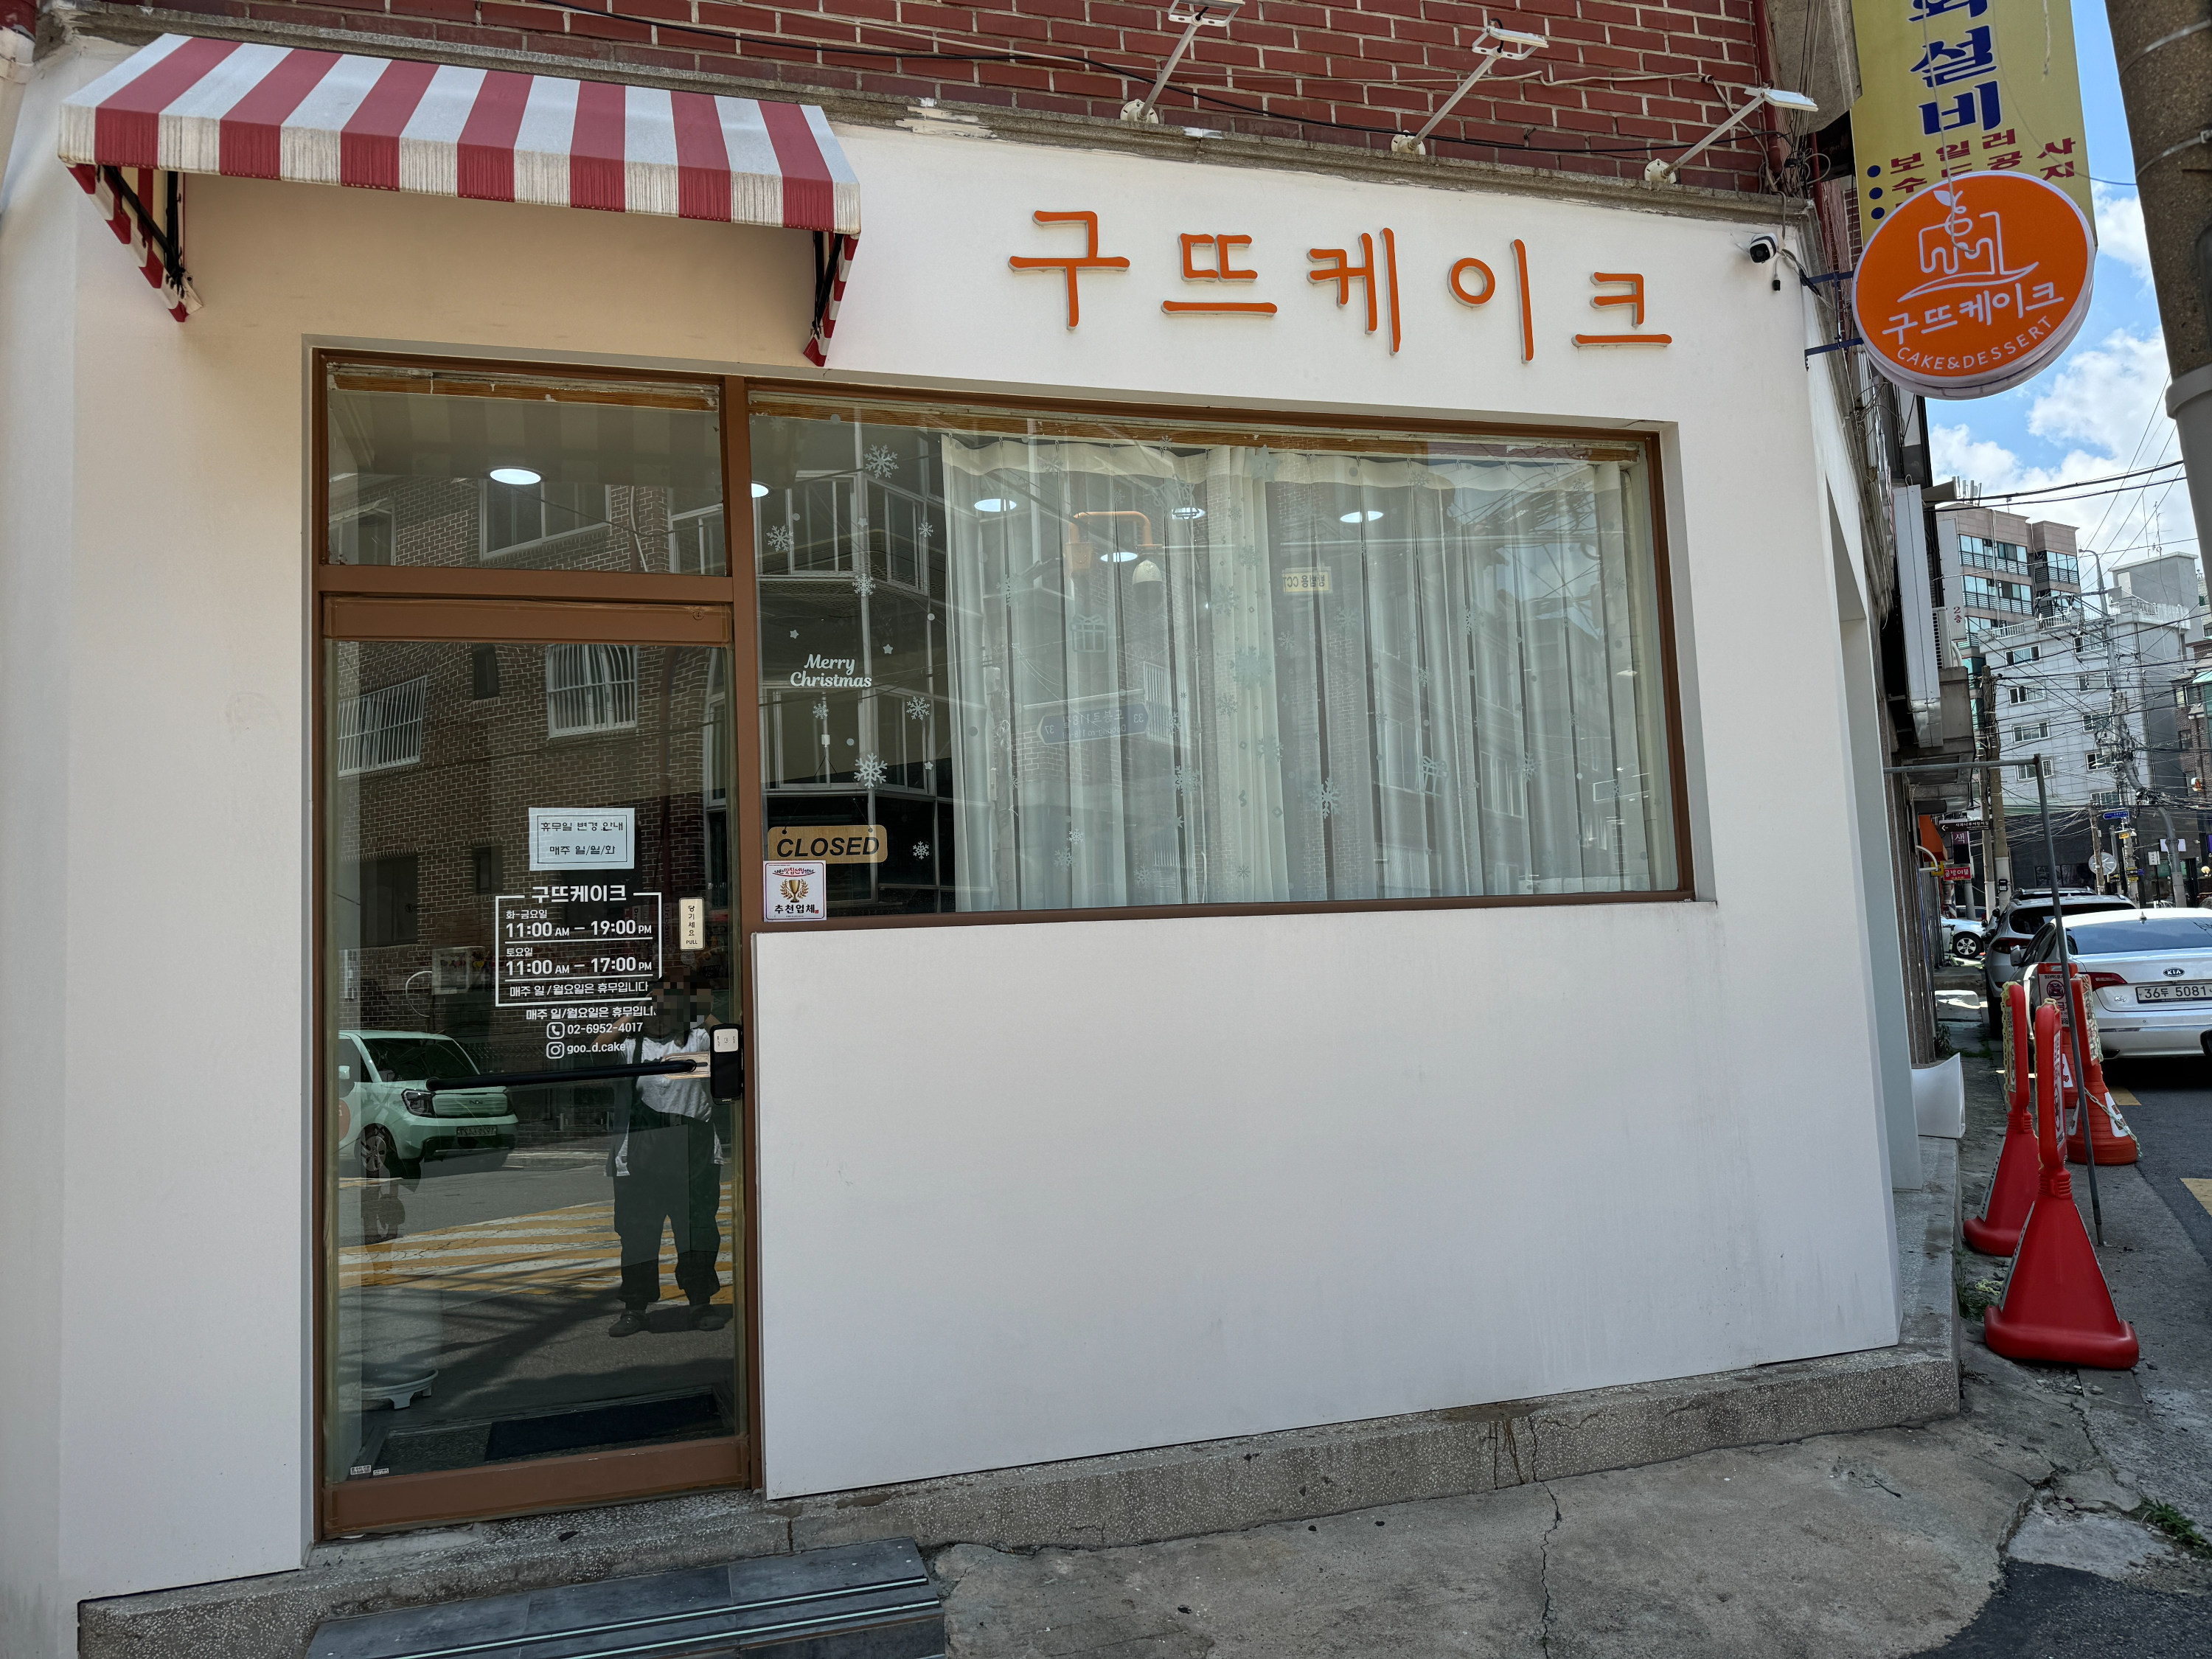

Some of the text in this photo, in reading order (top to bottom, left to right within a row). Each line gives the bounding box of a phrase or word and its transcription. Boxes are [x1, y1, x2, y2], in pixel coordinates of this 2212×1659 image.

[1891, 128, 2017, 175] 보일러
[1008, 209, 1673, 364] 구뜨케이크
[1882, 282, 2065, 345] 구뜨케이크
[1897, 316, 2052, 369] CAKE&DESSERT
[1953, 606, 1963, 623] 2층
[804, 654, 855, 675] Merry
[790, 670, 872, 688] Christmas
[540, 822, 623, 832] 휴무일 변경 안내
[549, 845, 616, 855] 매주 일/월/화
[776, 836, 880, 858] CLOSED
[532, 885, 627, 903] 구뜨케이크
[506, 909, 548, 919] 화-금요일
[774, 904, 815, 914] 추천업체
[506, 922, 552, 938] 11:00
[554, 927, 570, 936] AM
[591, 920, 636, 936] 19:00
[638, 925, 652, 933] PM
[506, 947, 533, 957] 토요일
[506, 959, 552, 975] 11:00
[554, 964, 570, 974] AM
[591, 957, 636, 973] 17:00
[638, 961, 653, 971] PM
[509, 986, 531, 997] 매주
[597, 981, 649, 993] 휴무입니다
[2144, 985, 2207, 998] 36두 5081
[526, 1006, 657, 1020] 매주 일/월요일은 휴무입니
[567, 1022, 644, 1034] 02-6952-4017
[566, 1041, 626, 1054] goo_d.cake
